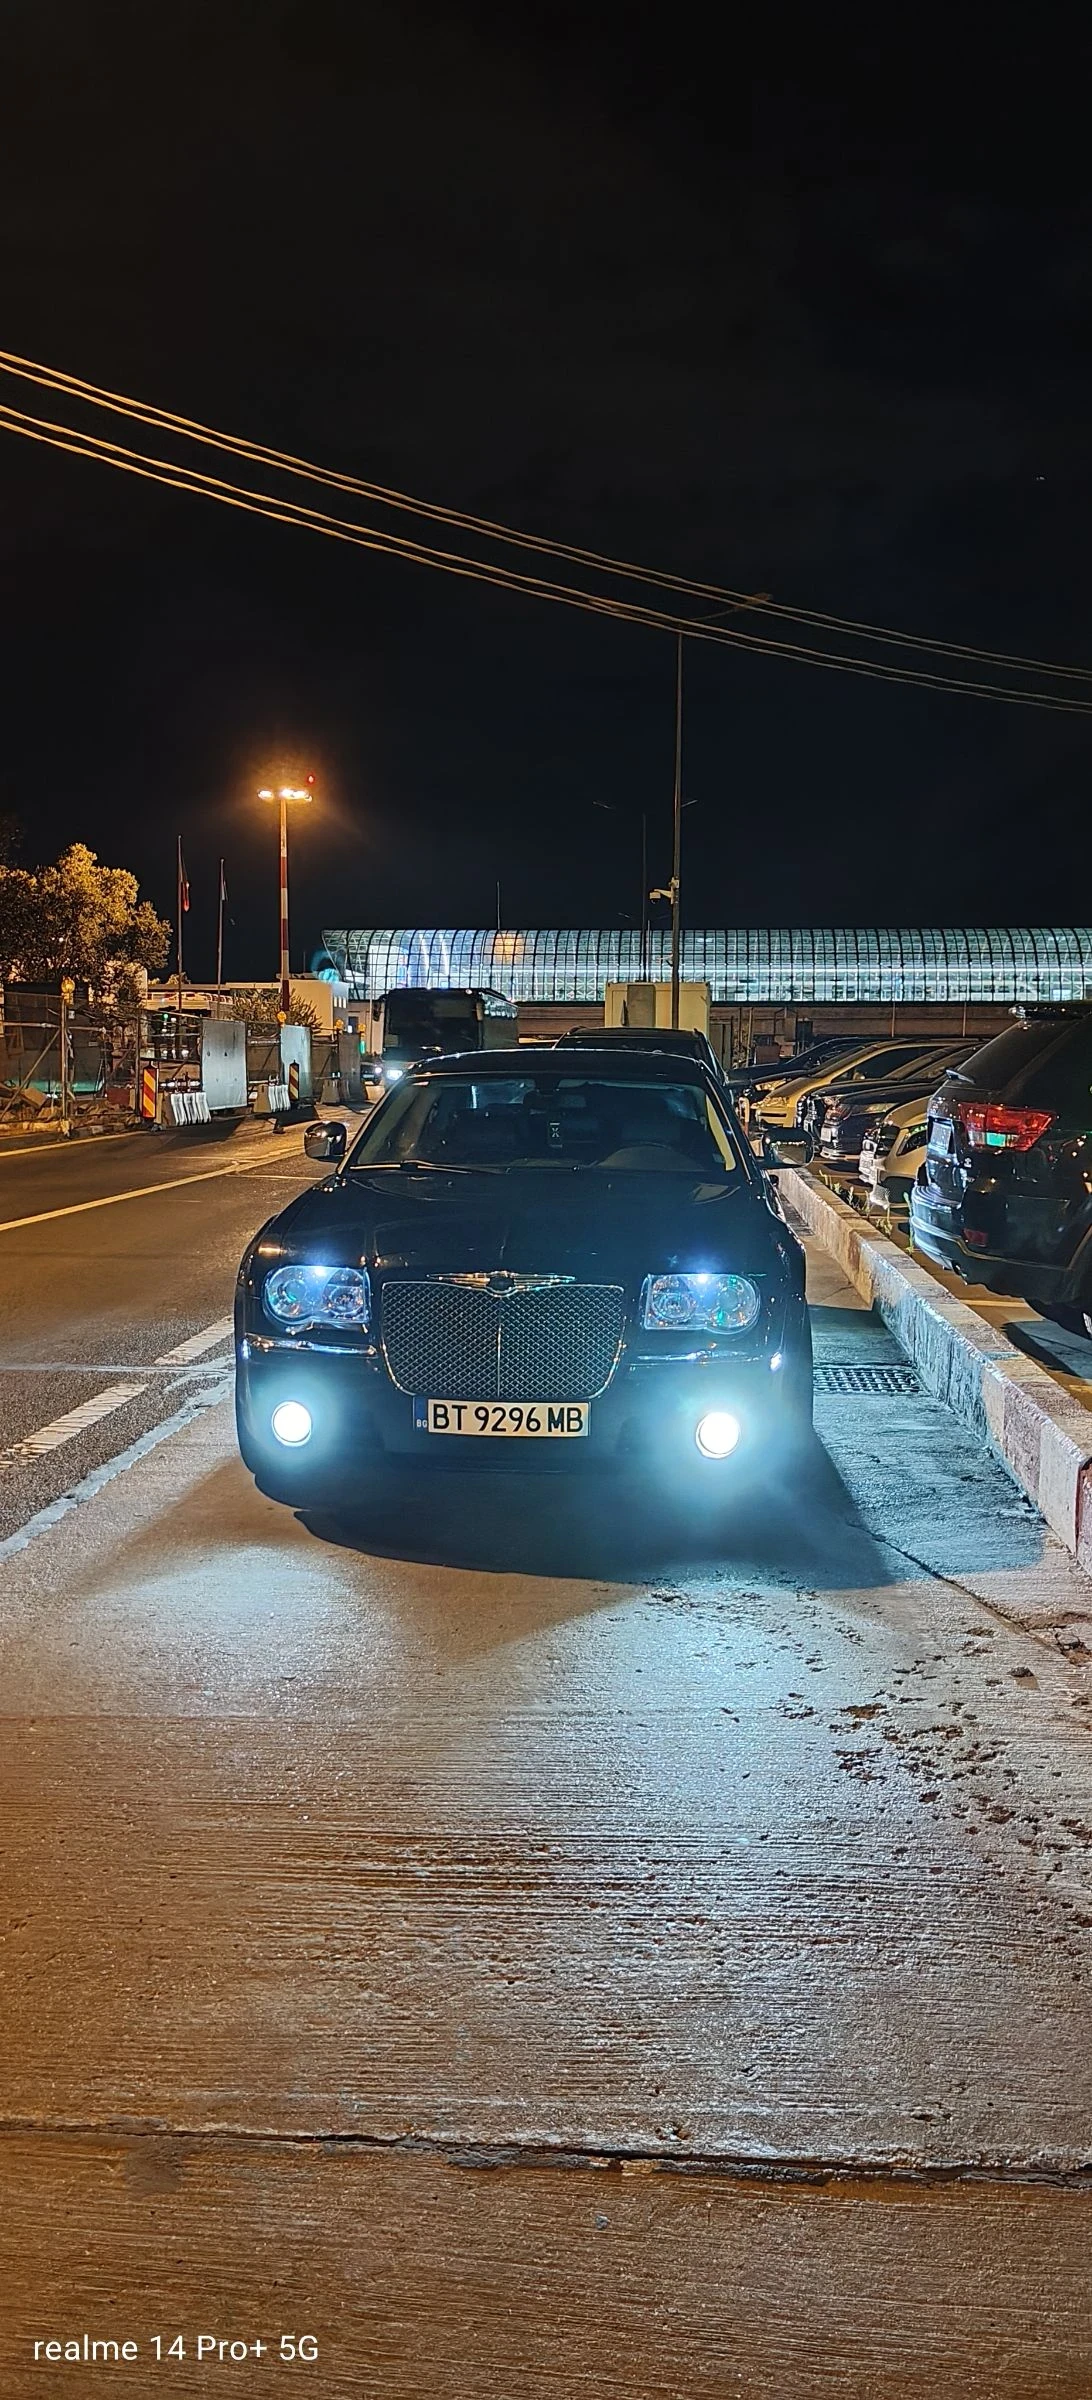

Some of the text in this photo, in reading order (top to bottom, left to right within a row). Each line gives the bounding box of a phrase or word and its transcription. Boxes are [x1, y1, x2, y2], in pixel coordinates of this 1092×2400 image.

[433, 1404, 467, 1430] BT
[474, 1406, 541, 1432] 9296
[547, 1407, 583, 1432] MB
